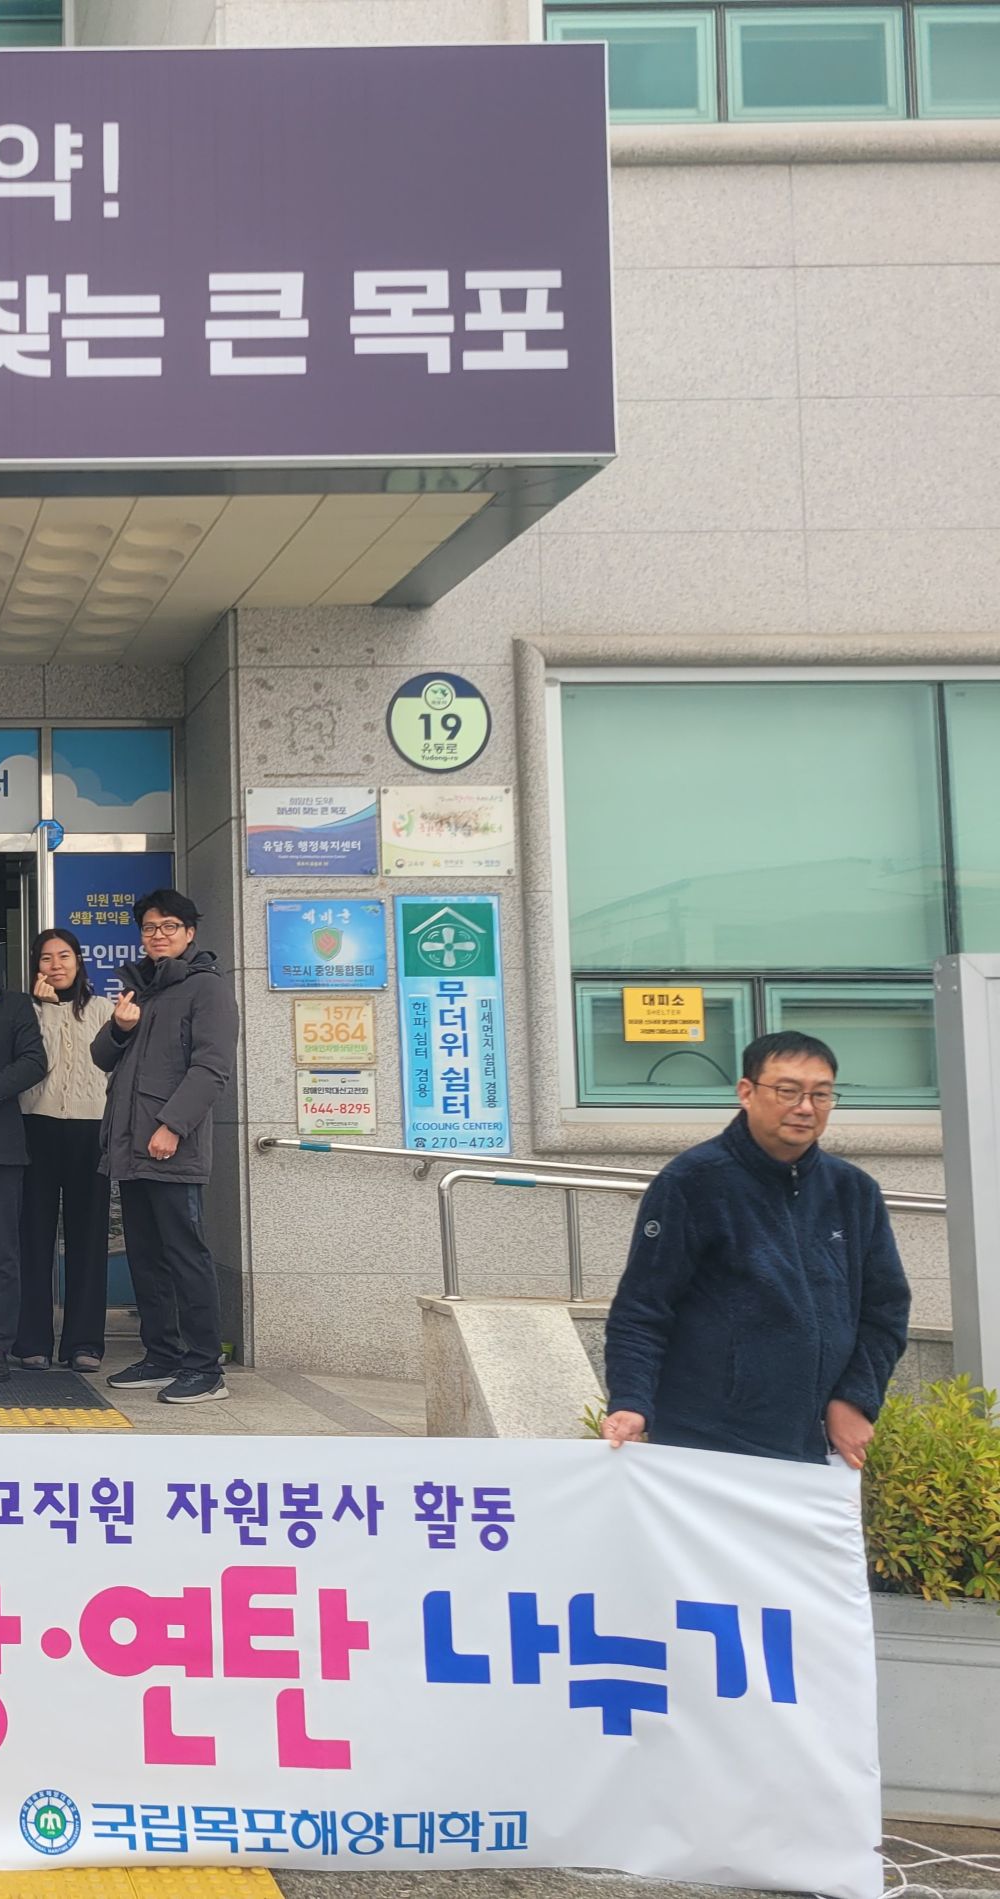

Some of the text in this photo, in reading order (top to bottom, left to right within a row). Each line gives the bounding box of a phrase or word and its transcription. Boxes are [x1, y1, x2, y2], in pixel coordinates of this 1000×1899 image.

[205, 271, 309, 376] 큰
[349, 269, 569, 374] 목포
[417, 712, 462, 741] 19
[262, 840, 361, 853] 유달동 행정복지센터
[86, 893, 109, 907] 민원
[68, 911, 130, 926] 생활 편익을
[282, 964, 375, 977] 목포시 중앙통합동대
[641, 994, 685, 1006] 대피소
[303, 1022, 368, 1043] 5364
[411, 1001, 431, 1098] 한파 쉼터 겸용
[435, 980, 471, 1120] 무더위 쉼터
[480, 998, 499, 1109] 미세먼지 쉼터 겸용
[302, 1103, 371, 1114] 1644-8295
[412, 1121, 503, 1132] (COOLING CENTER)
[431, 1136, 505, 1149] 270-4732
[165, 1478, 386, 1549] 자원봉사
[413, 1480, 517, 1553] 활동
[421, 1589, 798, 1737] 나누기
[90, 1802, 529, 1858] 국립목포해양대학교
